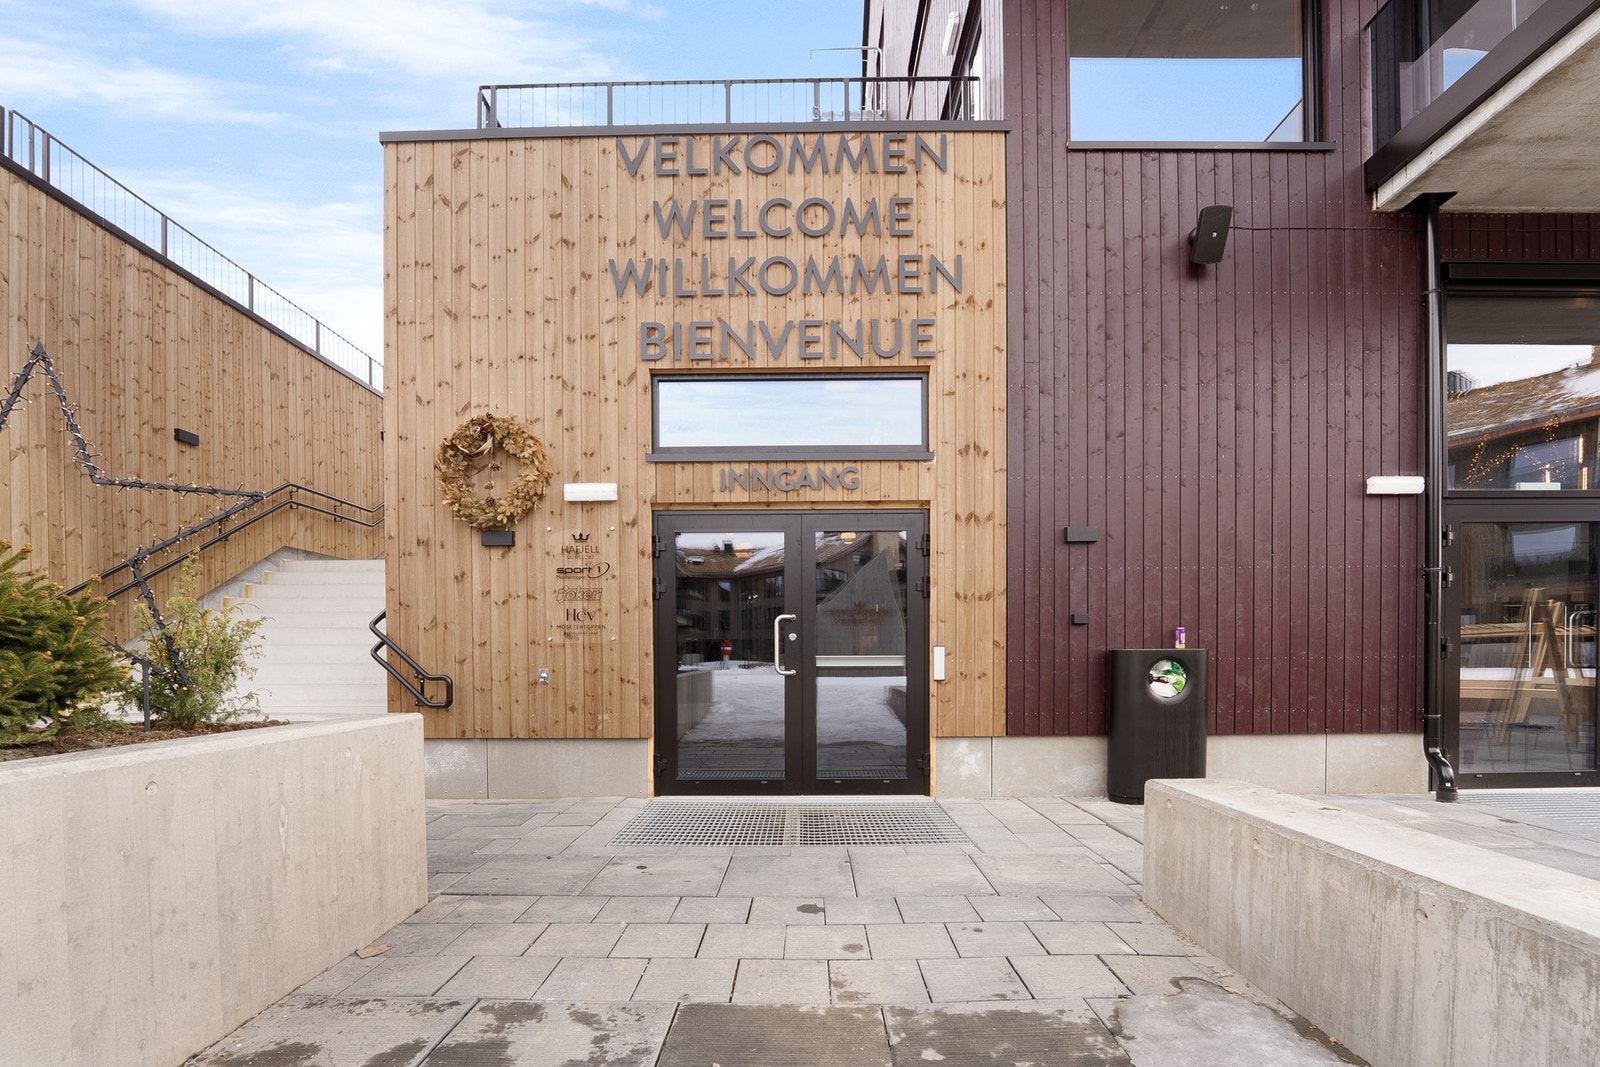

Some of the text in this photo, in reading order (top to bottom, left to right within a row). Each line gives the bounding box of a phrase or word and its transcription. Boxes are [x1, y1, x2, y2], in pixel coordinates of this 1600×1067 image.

[616, 133, 948, 177] VELKOMMEN
[653, 197, 914, 239] WELCOME
[608, 254, 963, 298] WILLKOMMEN
[640, 318, 936, 361] BIENVENUE
[719, 465, 860, 493] INNGANG
[561, 545, 600, 554] HAFJELL
[556, 567, 593, 575] sport
[556, 585, 602, 604] joker
